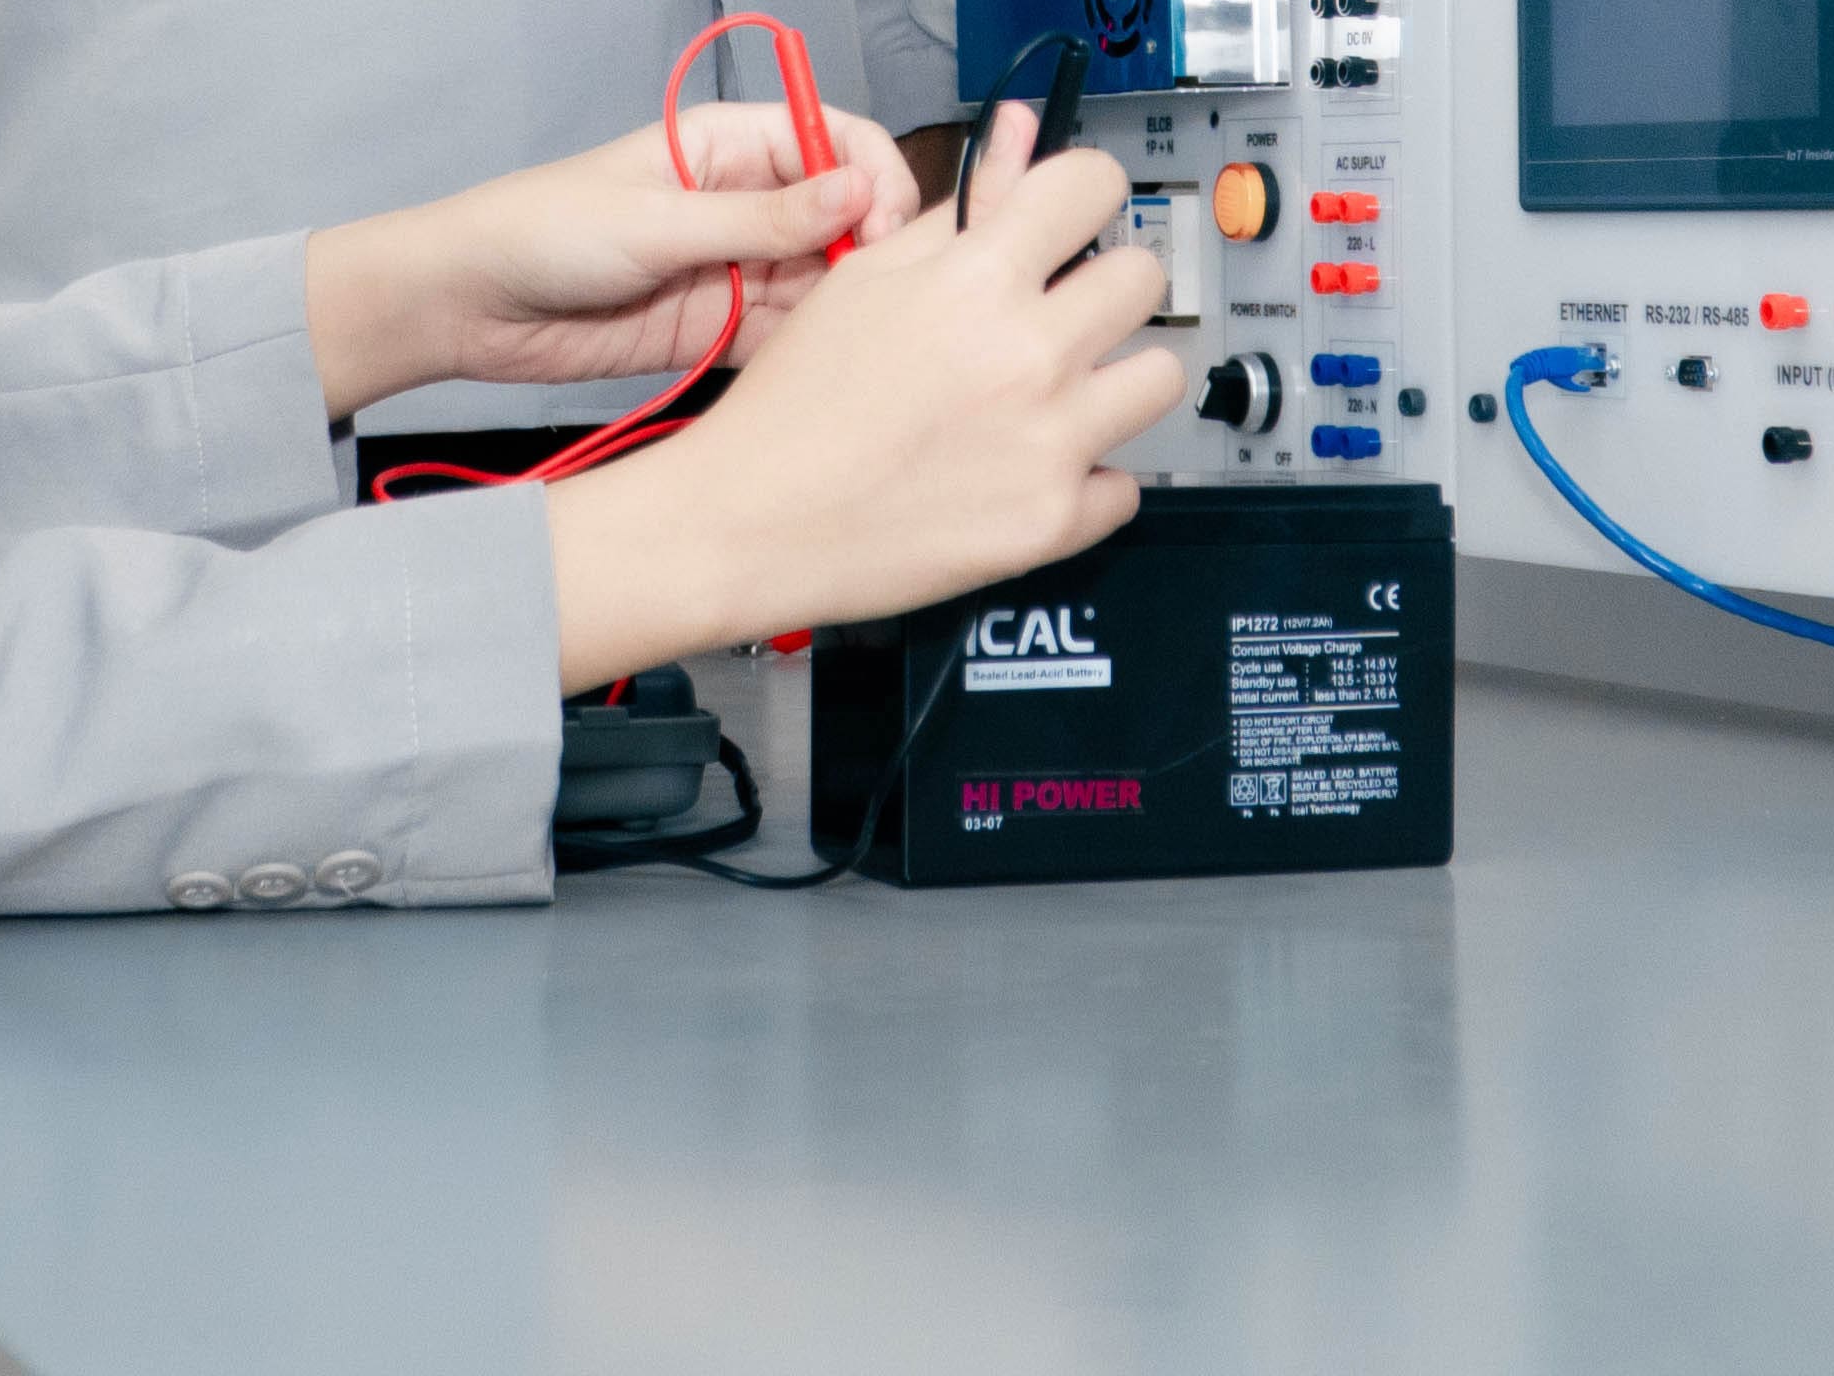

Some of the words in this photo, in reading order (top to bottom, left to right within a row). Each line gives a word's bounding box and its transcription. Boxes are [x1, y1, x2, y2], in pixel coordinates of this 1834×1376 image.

[1347, 32, 1359, 45] DC
[1167, 141, 1174, 154] N
[1247, 134, 1278, 146] POWER
[1336, 157, 1348, 169] AC
[1347, 237, 1362, 251] 220
[1369, 237, 1375, 250] L
[1231, 304, 1261, 316] POWER
[1263, 304, 1296, 318] SWITCH
[1560, 304, 1628, 323] ETHERNET
[1646, 305, 1691, 324] RS-232
[1702, 307, 1749, 326] RS-485
[1777, 366, 1823, 386] INPUT
[1348, 399, 1363, 412] 220
[1369, 399, 1377, 413] N
[1239, 450, 1251, 463] ON
[1276, 453, 1292, 466] OFF
[1232, 618, 1278, 632] IP1272
[1232, 645, 1279, 656] Constant
[1283, 644, 1321, 657] Voltage
[1324, 642, 1362, 655] Charge
[1232, 663, 1261, 675] Cycle
[1265, 663, 1283, 672] use
[1389, 658, 1397, 669] V
[973, 671, 1007, 681] Sealed
[1012, 670, 1063, 679] Lead-Acid
[1067, 669, 1103, 679] Battery
[1232, 678, 1273, 690] Standby
[1278, 677, 1297, 687] use
[1389, 672, 1397, 683] V
[1232, 692, 1259, 703] Initial
[1262, 692, 1298, 702] current
[1339, 690, 1361, 701] than
[1389, 688, 1397, 698] A
[962, 784, 1000, 812] HI
[1013, 780, 1141, 811] POWER
[965, 816, 1003, 832] 03-07
